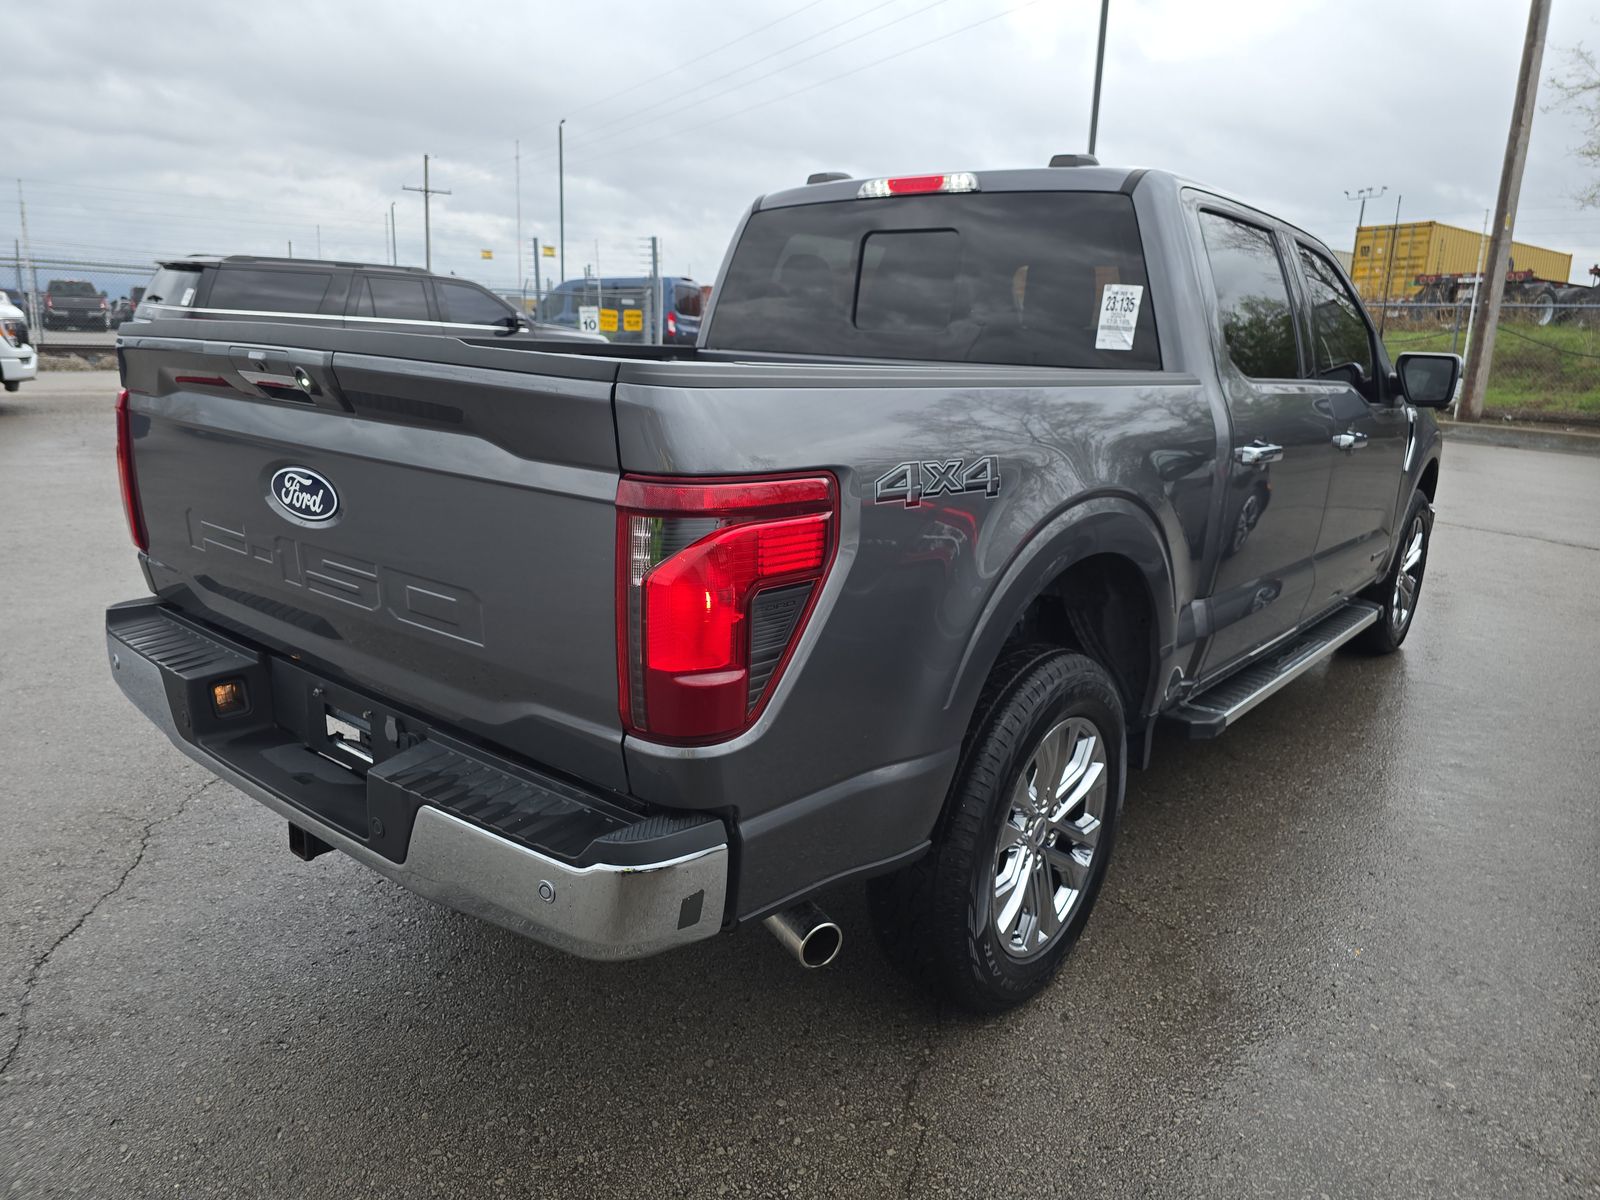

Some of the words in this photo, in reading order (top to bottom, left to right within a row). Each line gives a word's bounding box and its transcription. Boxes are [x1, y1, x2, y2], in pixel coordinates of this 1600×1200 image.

[583, 319, 597, 330] 10
[281, 472, 325, 514] Ford
[185, 506, 485, 648] F-150
